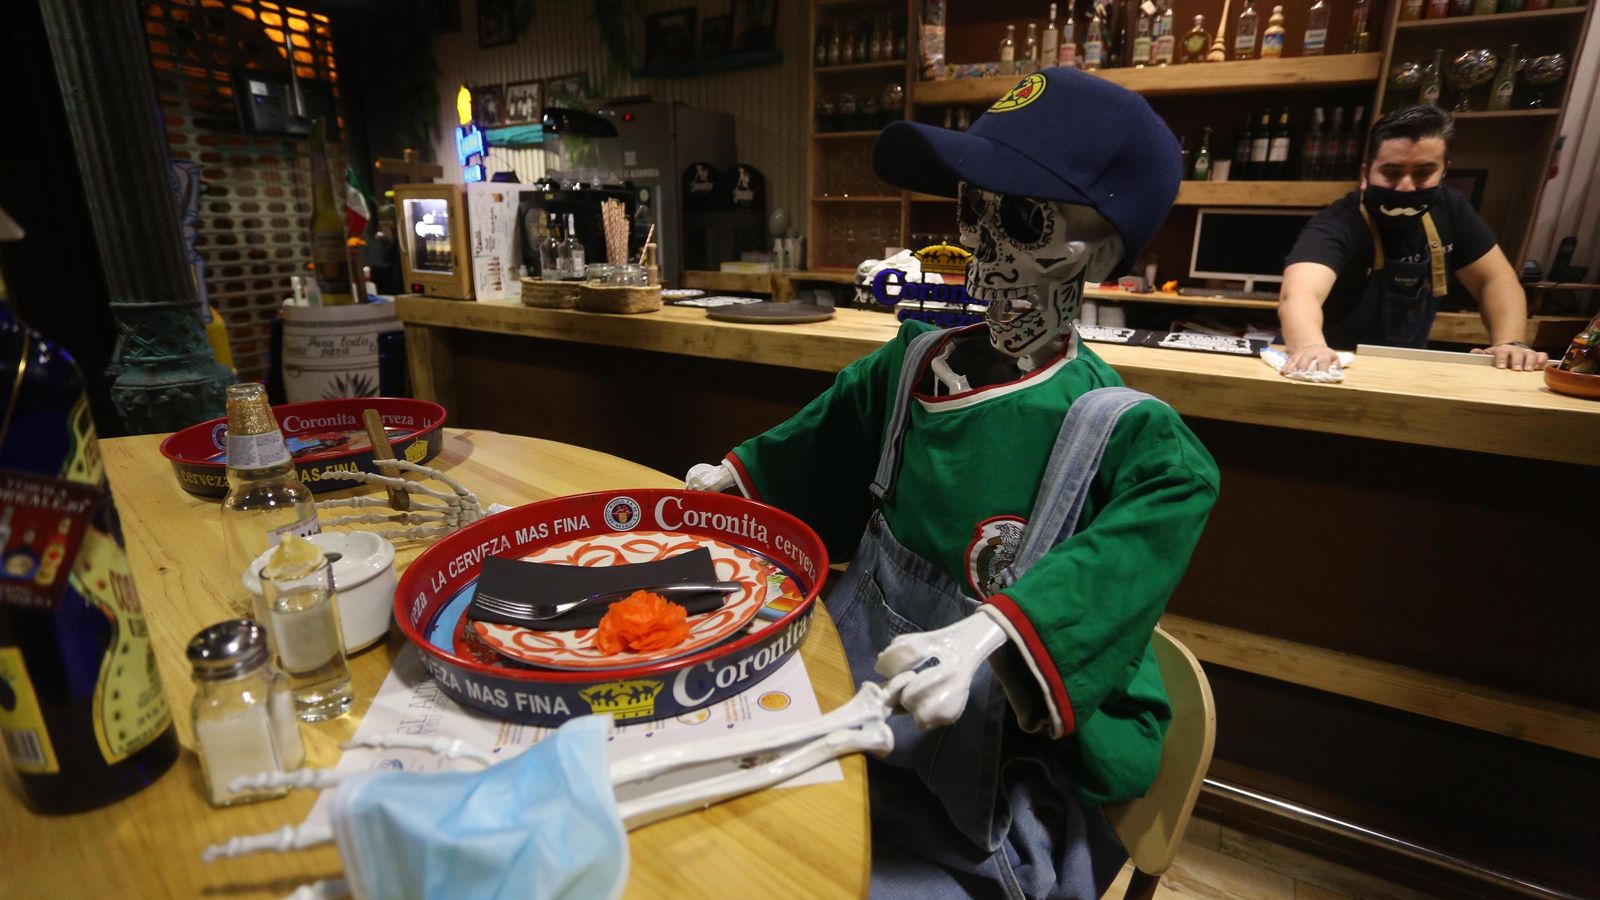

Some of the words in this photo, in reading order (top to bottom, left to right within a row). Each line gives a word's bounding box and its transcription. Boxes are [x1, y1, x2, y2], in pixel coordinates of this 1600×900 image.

[282, 413, 356, 433] Coronita
[654, 495, 769, 544] Coronita
[431, 570, 447, 594] LA
[448, 535, 511, 578] CERVEZA
[515, 522, 549, 546] MAS
[553, 514, 591, 535] FINA
[673, 615, 807, 708] Coronita
[465, 679, 509, 709] MAS
[514, 692, 571, 716] FINA
